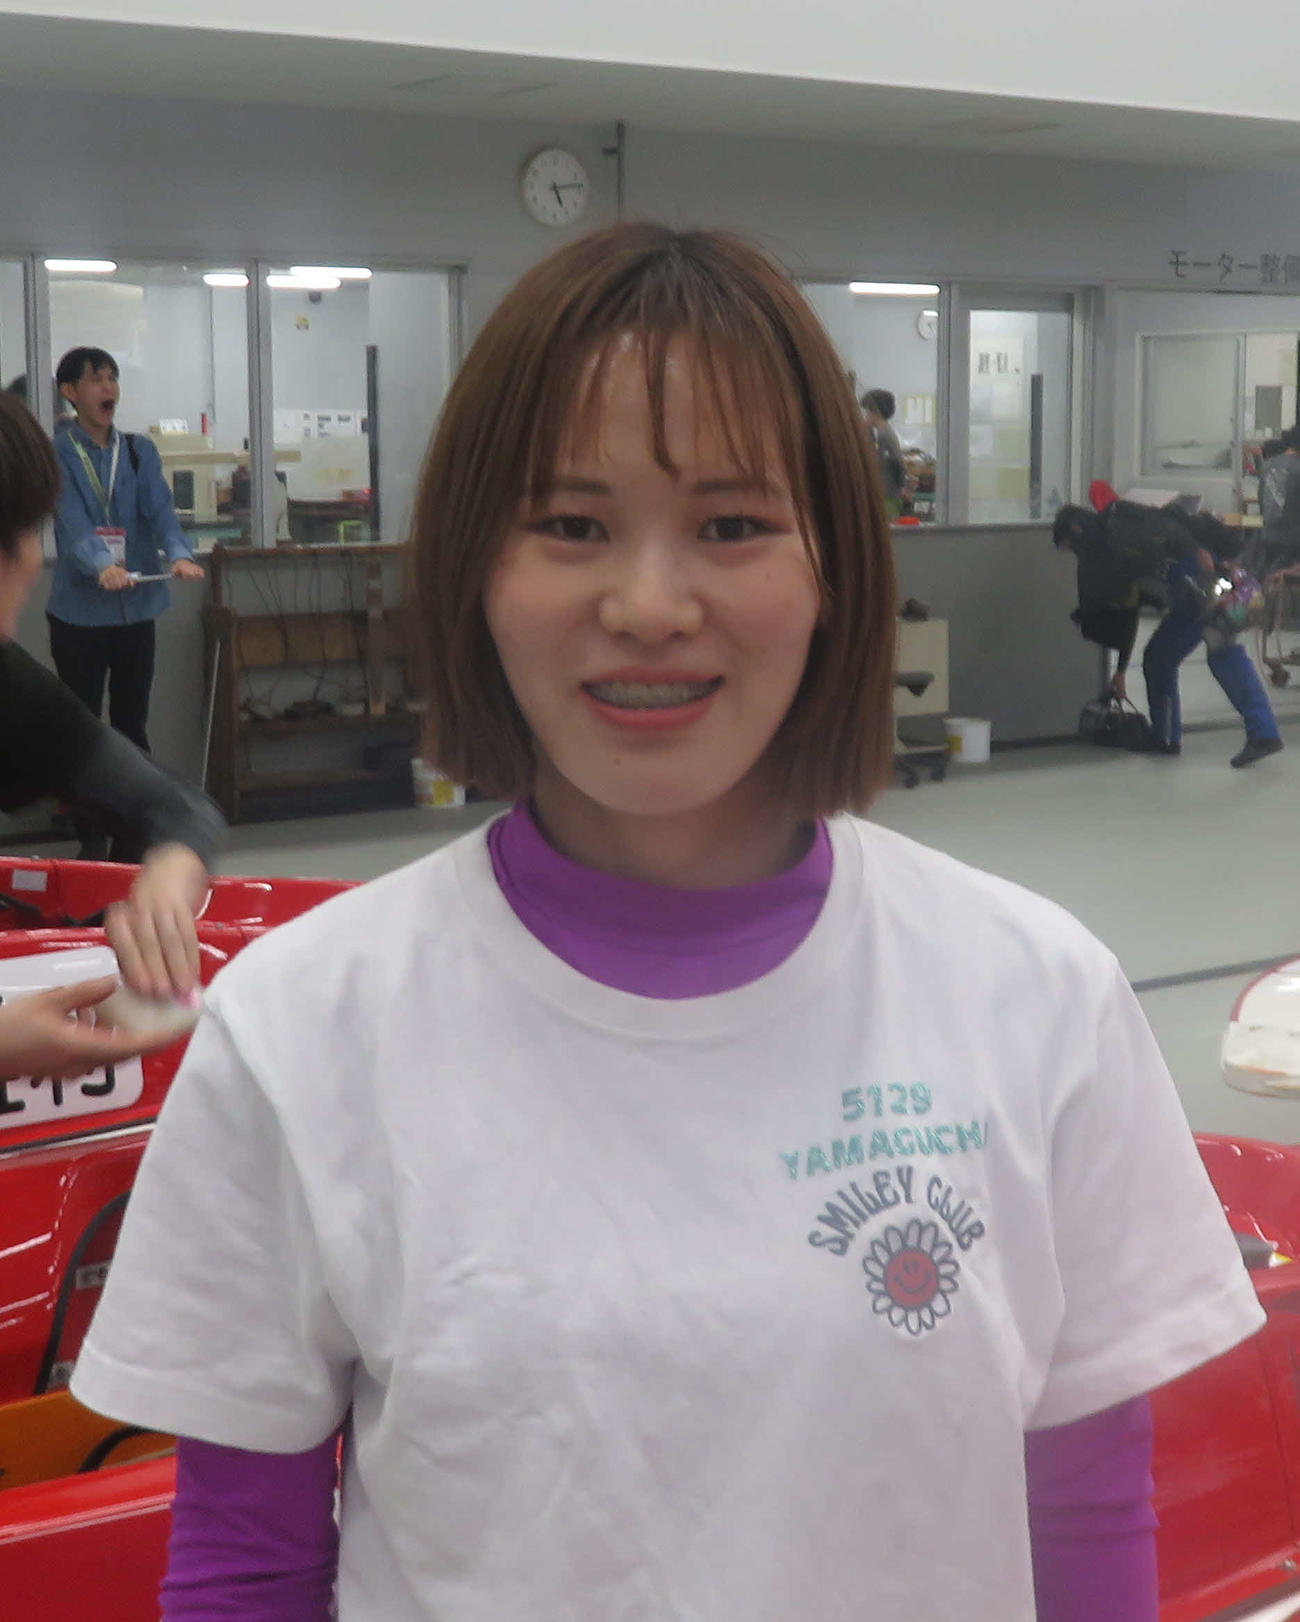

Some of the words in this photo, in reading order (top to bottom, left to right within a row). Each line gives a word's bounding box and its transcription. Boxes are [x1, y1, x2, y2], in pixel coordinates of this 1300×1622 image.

[841, 1081, 933, 1120] 5129
[808, 1165, 914, 1256] SMILEY
[927, 1174, 986, 1251] CLUB
